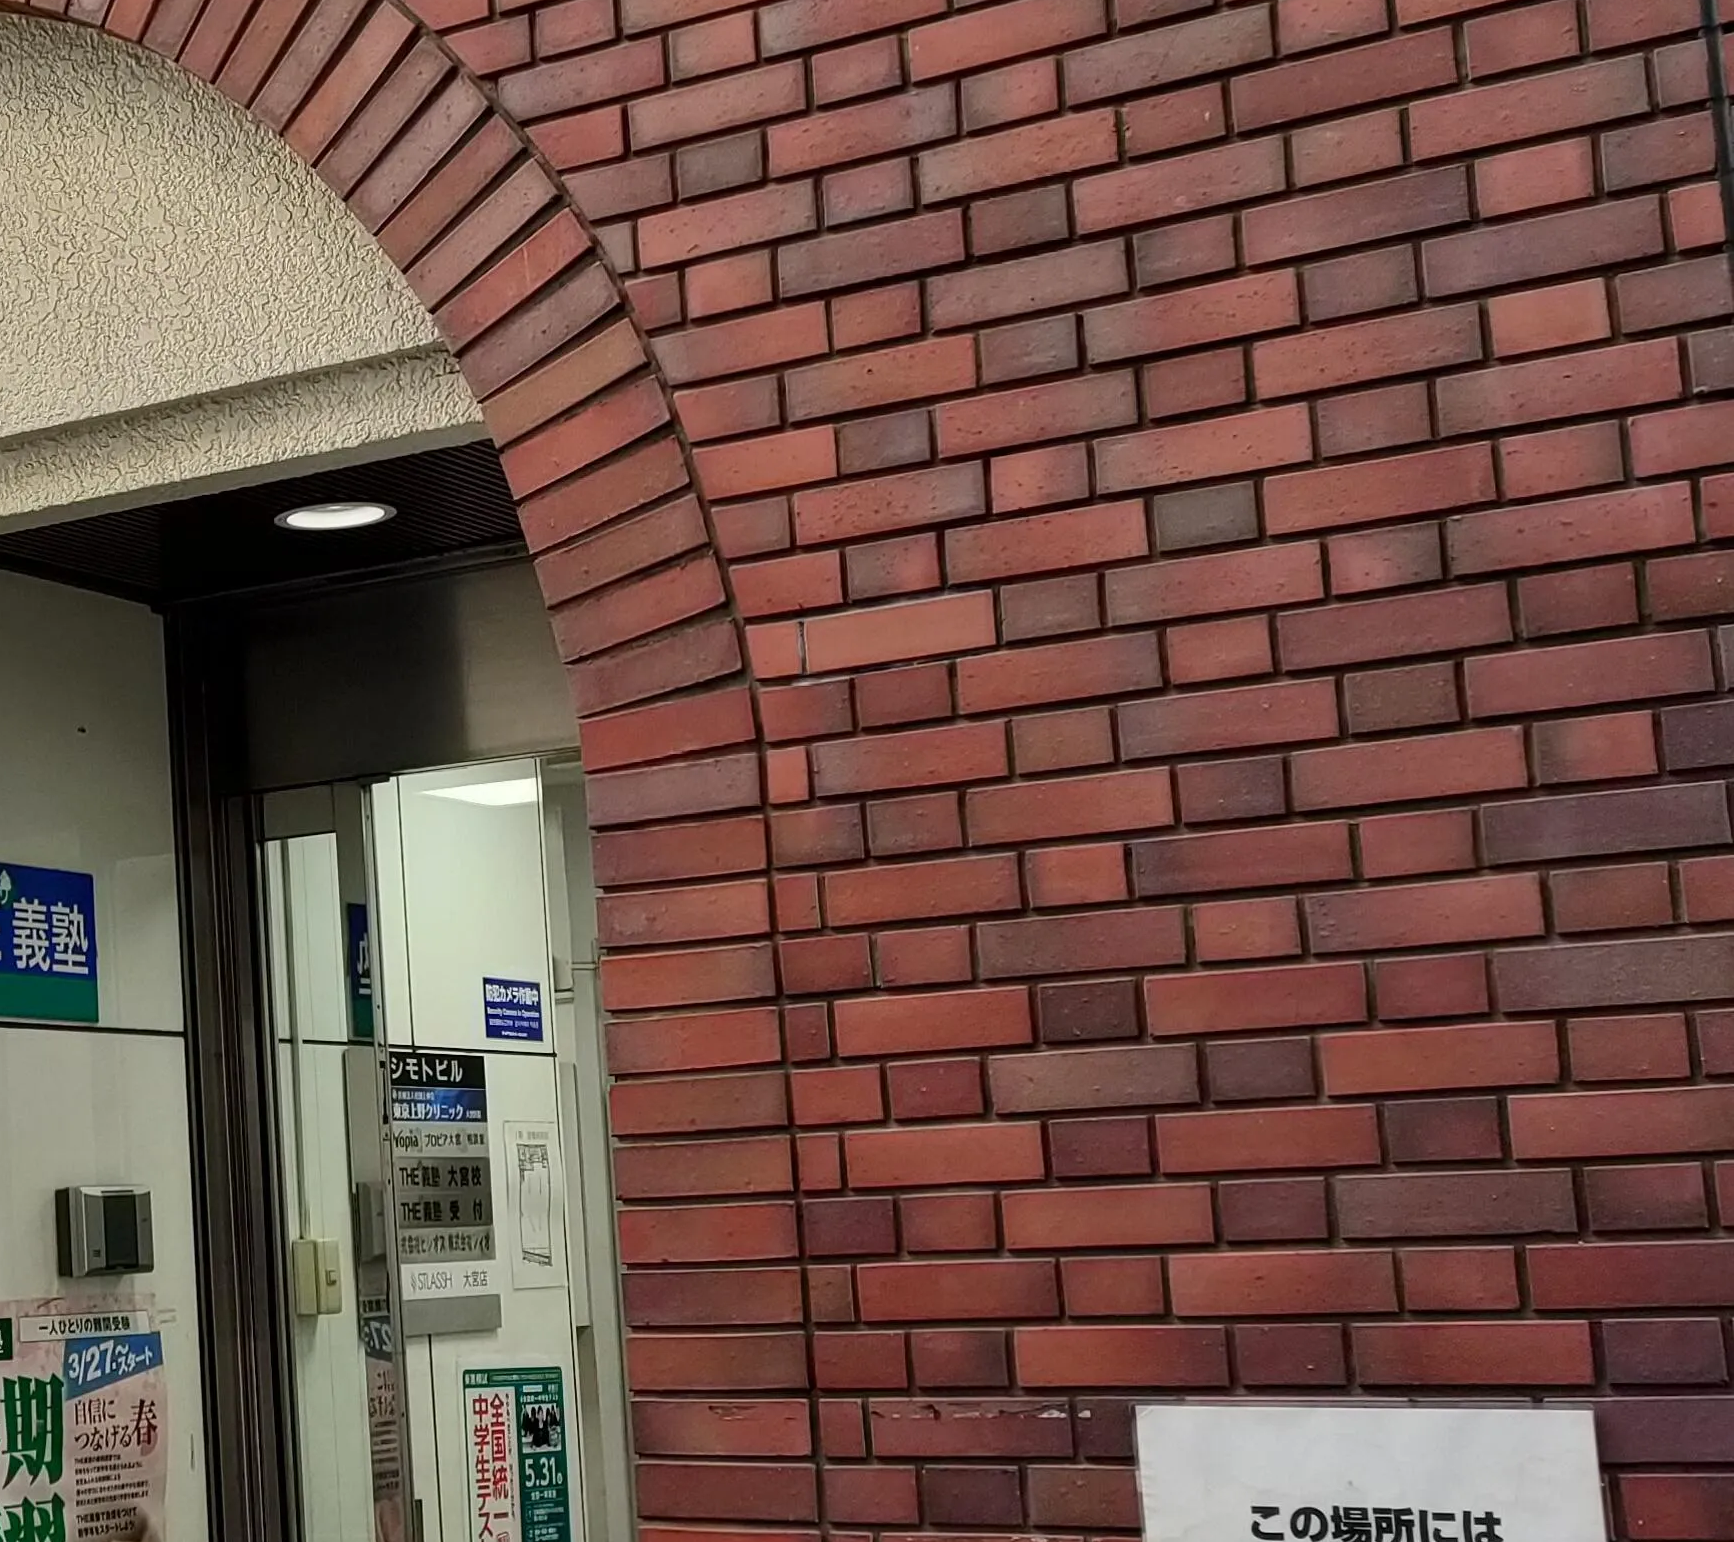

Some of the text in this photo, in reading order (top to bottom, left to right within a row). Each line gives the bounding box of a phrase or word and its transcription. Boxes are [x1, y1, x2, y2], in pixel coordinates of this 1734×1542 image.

[485, 984, 539, 1006] 防犯カメラ作動中
[393, 1102, 464, 1121] 東京上野クリニック
[448, 1165, 482, 1187] 大宮校
[463, 1270, 488, 1288] 大宮店
[74, 1398, 116, 1426] 自信に
